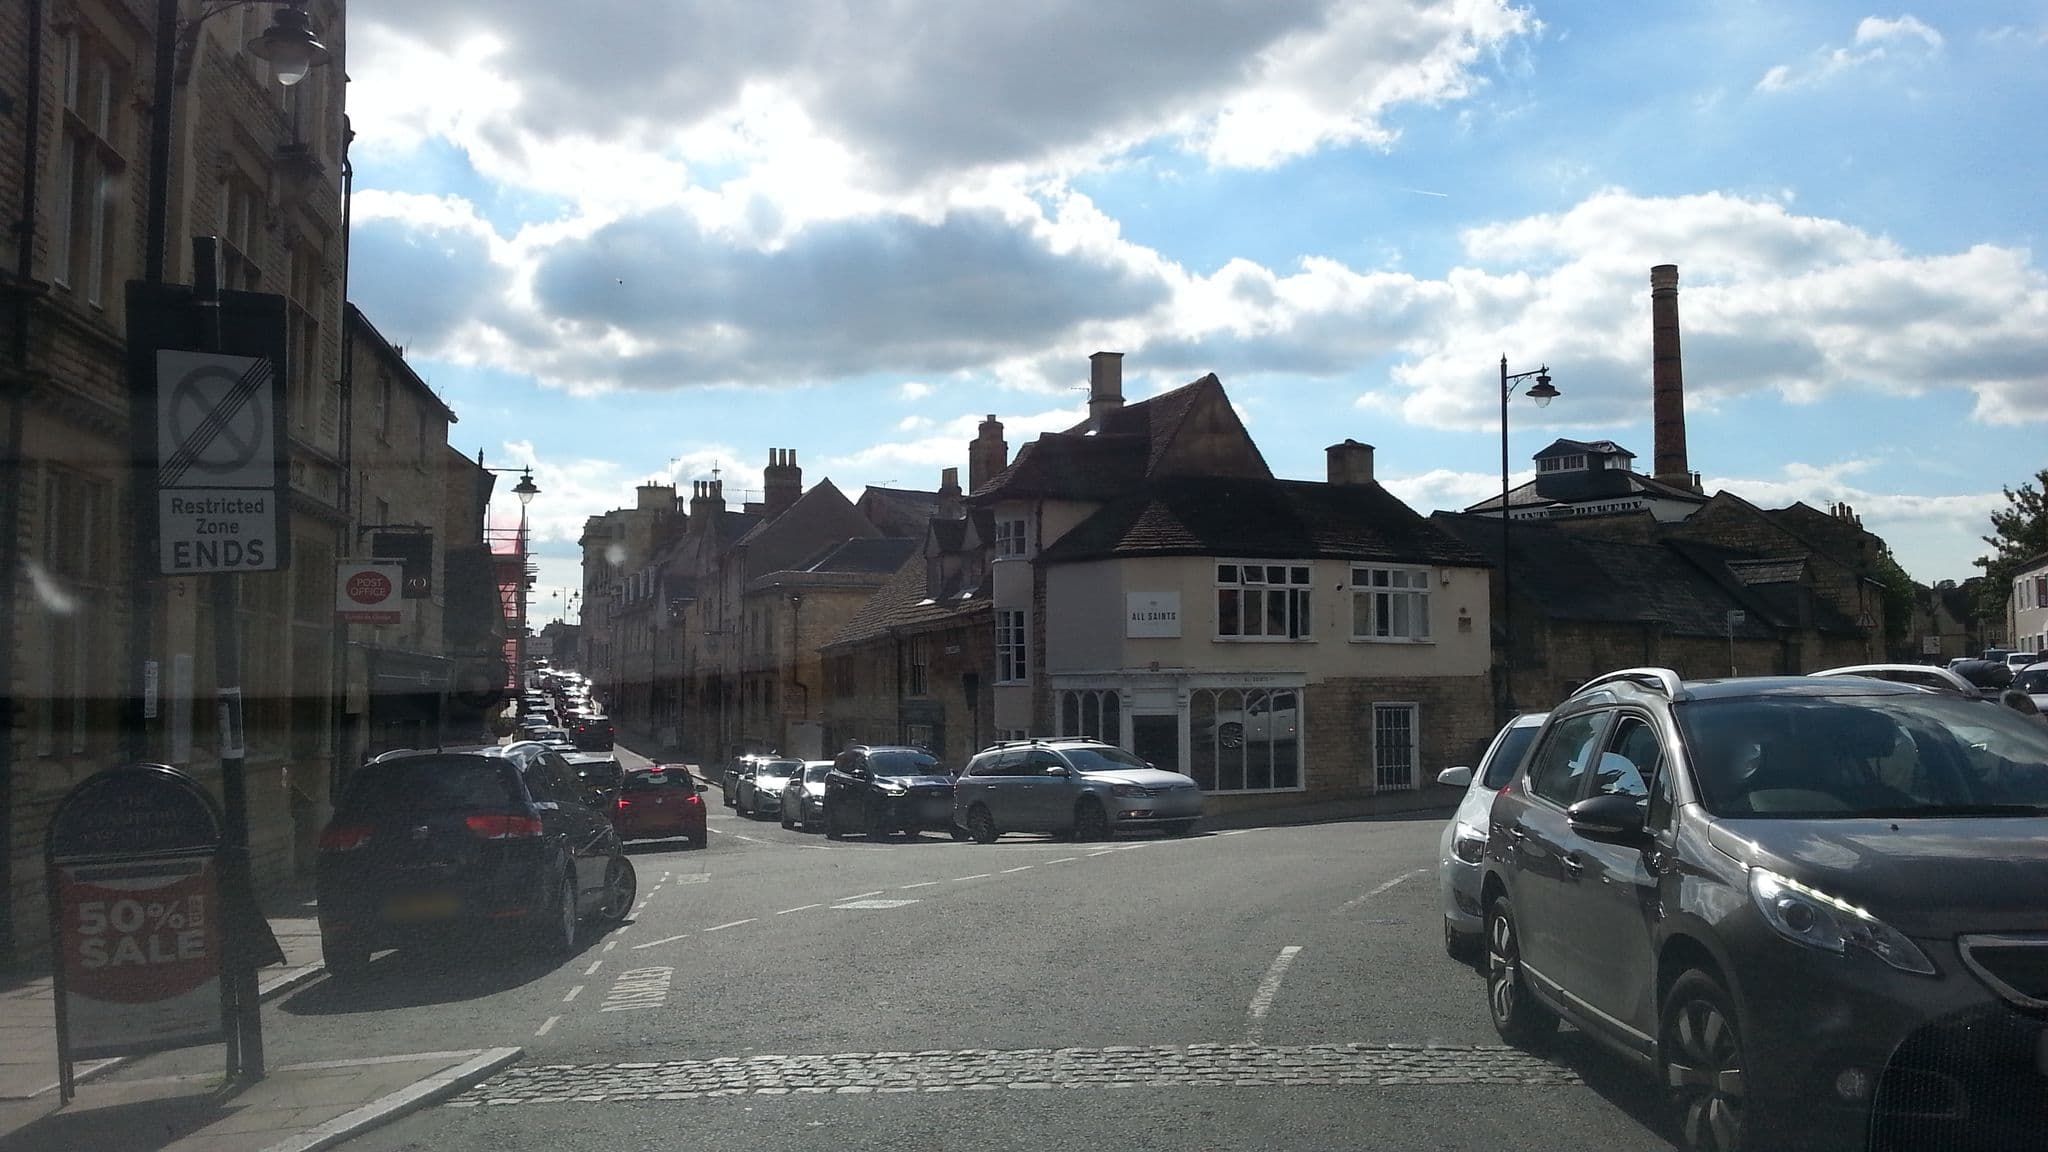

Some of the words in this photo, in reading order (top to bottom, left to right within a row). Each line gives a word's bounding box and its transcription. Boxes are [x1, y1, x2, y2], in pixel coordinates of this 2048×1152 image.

[172, 497, 265, 514] Restricted
[196, 518, 239, 534] Zone
[174, 539, 265, 568] ENDS
[356, 578, 383, 587] POST
[351, 587, 386, 597] OFFICE
[1132, 612, 1145, 621] ALL
[1148, 612, 1176, 621] SAINTS
[77, 899, 185, 936] 50%
[79, 930, 207, 969] SALE
